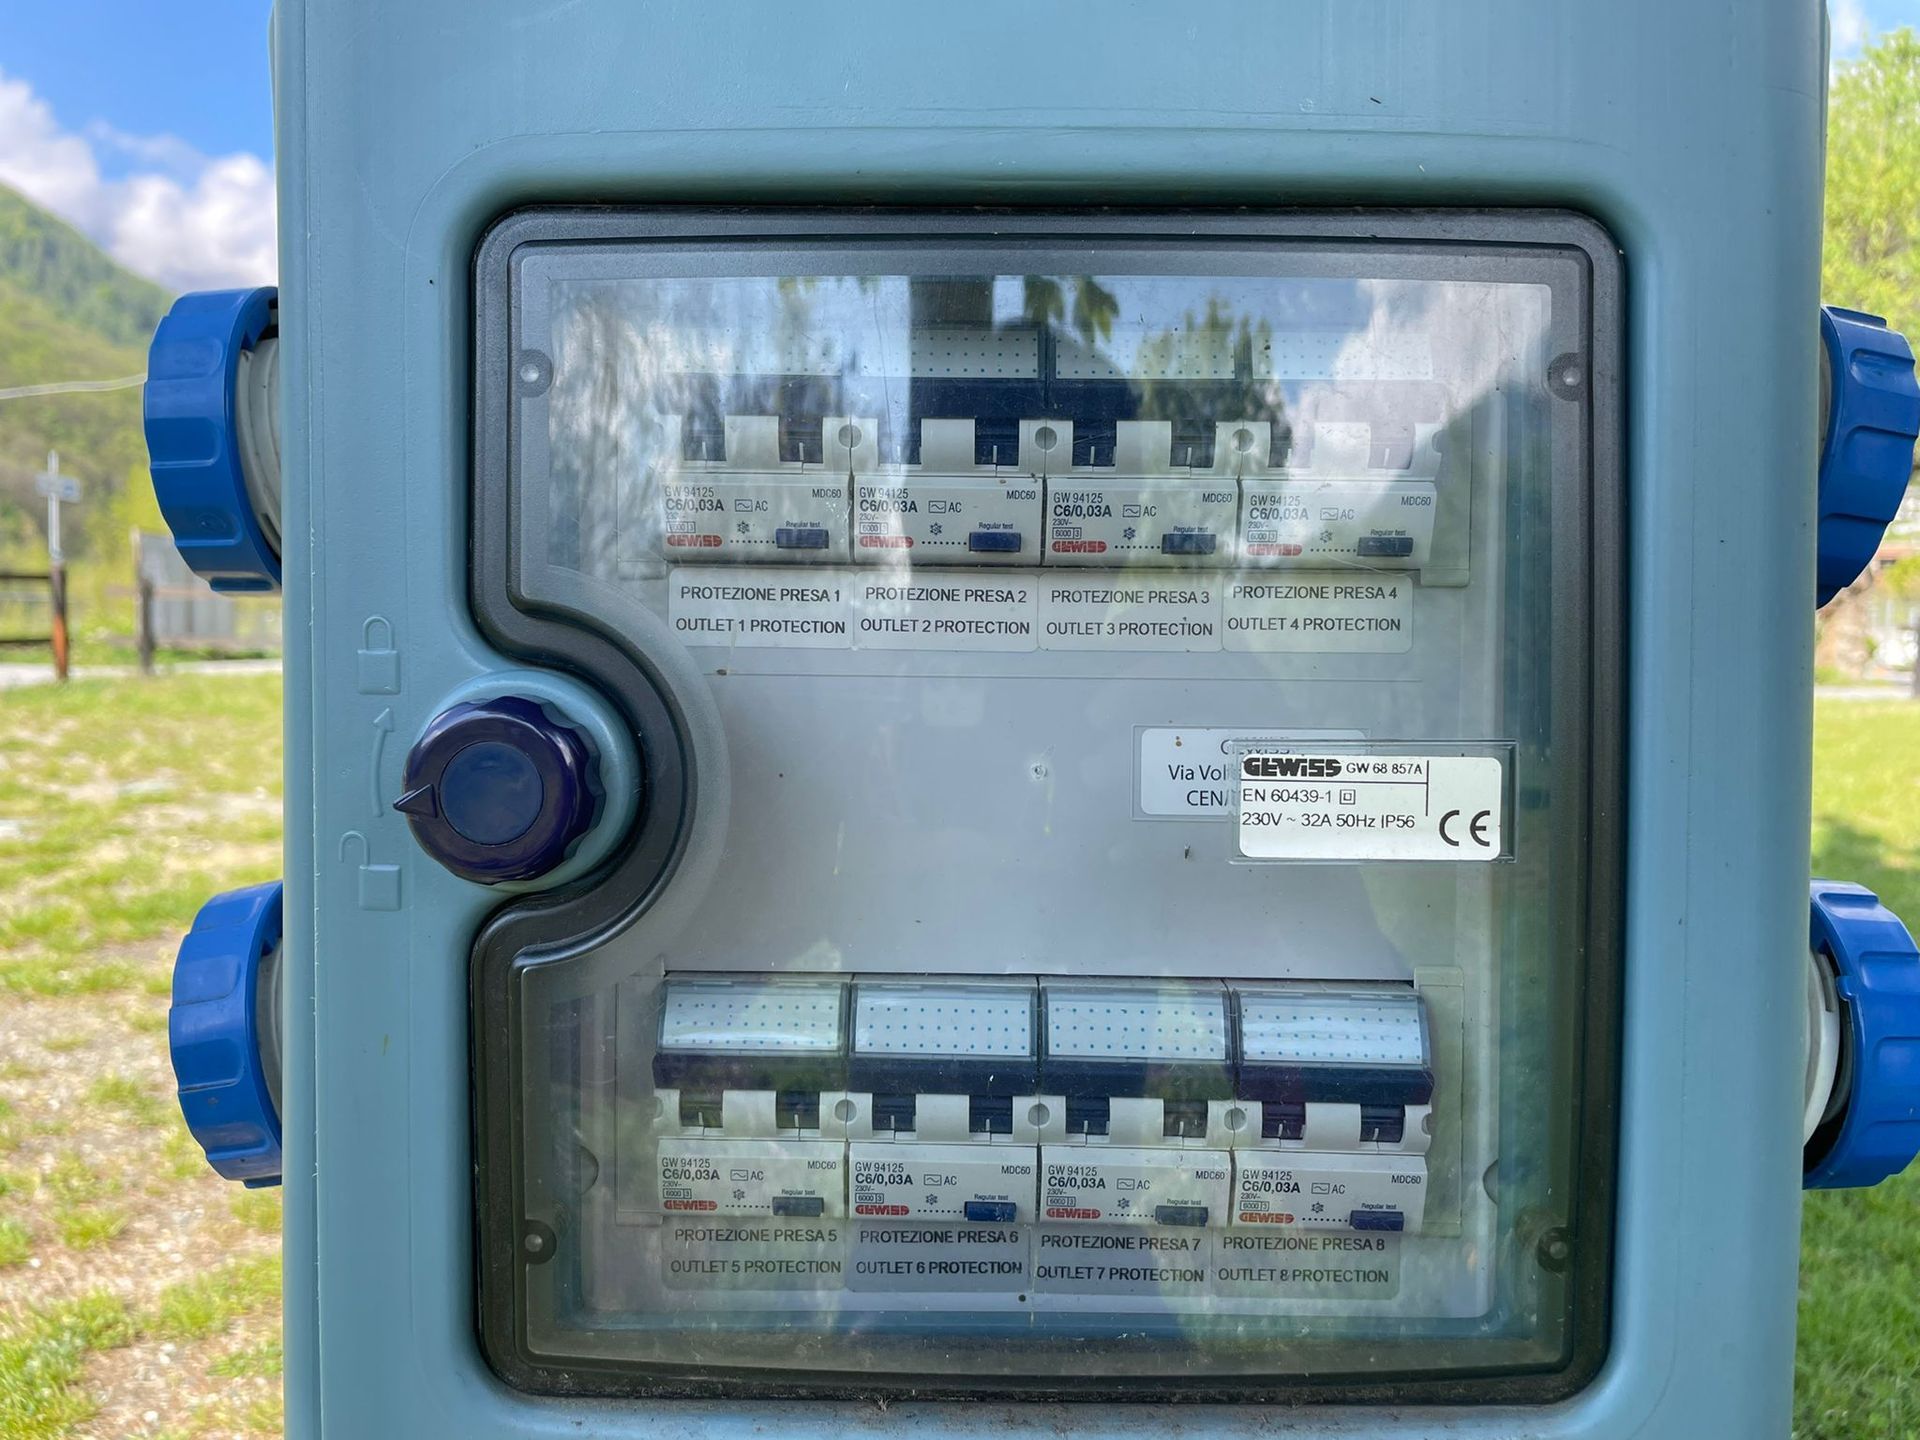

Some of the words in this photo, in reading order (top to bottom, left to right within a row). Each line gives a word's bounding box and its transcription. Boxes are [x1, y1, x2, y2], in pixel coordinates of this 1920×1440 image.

[664, 487, 683, 497] GW
[812, 489, 842, 498] MDC60
[859, 487, 876, 498] GW
[879, 488, 908, 498] 94125
[1007, 491, 1036, 500] MDC60
[1054, 492, 1071, 503] GW
[1073, 493, 1103, 503] 94125
[1202, 493, 1232, 502] MDC60
[666, 499, 724, 512] C6/0,03A
[755, 501, 768, 511] AC
[860, 500, 918, 513] C6/0,03A
[1251, 496, 1269, 506] GW
[1401, 496, 1431, 505] MDC60
[948, 502, 962, 513] AC
[1054, 505, 1112, 519] C6/0,03A
[1143, 506, 1156, 516] AC
[1250, 508, 1308, 521] C6/0,03A
[1340, 509, 1354, 519] AC
[681, 586, 776, 601] PROTEZIONE
[780, 589, 830, 602] PRESA
[834, 590, 840, 601] 1
[866, 587, 960, 601] PROTEZIONE
[965, 590, 1015, 602] PRESA
[1018, 591, 1026, 603] 2
[1052, 590, 1144, 603] PROTEZIONE
[1149, 591, 1198, 604] PRESA
[1201, 591, 1209, 603] 3
[1233, 586, 1329, 599] PROTEZIONE
[1334, 586, 1385, 599] PRESA
[1389, 587, 1397, 599] 4
[676, 618, 734, 631] OUTLET
[739, 620, 745, 631] 1
[750, 620, 845, 633] PROTECTION
[861, 618, 919, 632] OUTLET
[922, 620, 931, 632] 2
[935, 620, 1030, 634] PROTECTION
[1047, 622, 1104, 635] OUTLET
[1107, 623, 1115, 635] 3
[1119, 623, 1213, 636] PROTECTION
[1228, 618, 1287, 630] OUTLET
[1290, 618, 1299, 630] 4
[1304, 618, 1400, 631] PROTECTION
[1169, 765, 1194, 780] Via
[1347, 763, 1369, 773] GW
[1373, 763, 1387, 773] 68
[1392, 764, 1422, 774] 857A
[1243, 789, 1265, 801] EN
[1271, 789, 1331, 803] 60439-1
[1242, 812, 1282, 826] 230V
[1301, 814, 1332, 826] 32A
[1337, 814, 1375, 828] 50Hz
[1381, 815, 1415, 828] IP56
[1439, 810, 1490, 846] CE
[662, 1158, 680, 1168] GW
[681, 1158, 710, 1168] 94125
[808, 1161, 836, 1170] MDC60
[855, 1162, 872, 1172] GW
[874, 1163, 903, 1172] 94125
[663, 1169, 720, 1181] C6/0,03A
[751, 1171, 764, 1180] AC
[1001, 1166, 1030, 1174] MDC60
[1048, 1166, 1065, 1176] GW
[1068, 1166, 1097, 1176] 94125
[1196, 1171, 1225, 1179] MDC60
[1243, 1170, 1260, 1180] GW
[1262, 1171, 1292, 1180] 94125
[855, 1174, 913, 1186] C6/0,03A
[944, 1176, 957, 1185] AC
[1048, 1177, 1105, 1190] C6/0,03A
[1137, 1180, 1150, 1190] AC
[1391, 1175, 1421, 1184] MDC60
[1242, 1182, 1300, 1194] C6/0,03A
[1332, 1185, 1345, 1194] AC
[675, 1229, 769, 1241] PROTEZIONE
[774, 1229, 825, 1242] PRESA
[829, 1230, 837, 1241] 5
[860, 1231, 954, 1243] PROTEZIONE
[958, 1231, 1006, 1243] PRESA
[1010, 1231, 1018, 1243] 6
[1042, 1235, 1135, 1249] PROTEZIONE
[1139, 1237, 1189, 1250] PRESA
[1192, 1239, 1200, 1250] 7
[1223, 1237, 1319, 1250] PROTEZIONE
[1323, 1238, 1373, 1250] PRESA
[1376, 1239, 1385, 1250] 8
[671, 1261, 728, 1273] OUTLET
[732, 1261, 740, 1273] 5
[745, 1261, 841, 1273] PROTECTION
[856, 1262, 913, 1274] OUTLET
[916, 1262, 925, 1274] 6
[929, 1262, 1022, 1274] PROTECTION
[1037, 1266, 1094, 1279] OUTLET
[1098, 1267, 1105, 1279] 7
[1110, 1268, 1204, 1281] PROTECTION
[1218, 1268, 1276, 1281] OUTLET
[1280, 1270, 1289, 1281] 8
[1292, 1270, 1388, 1282] PROTECTION
